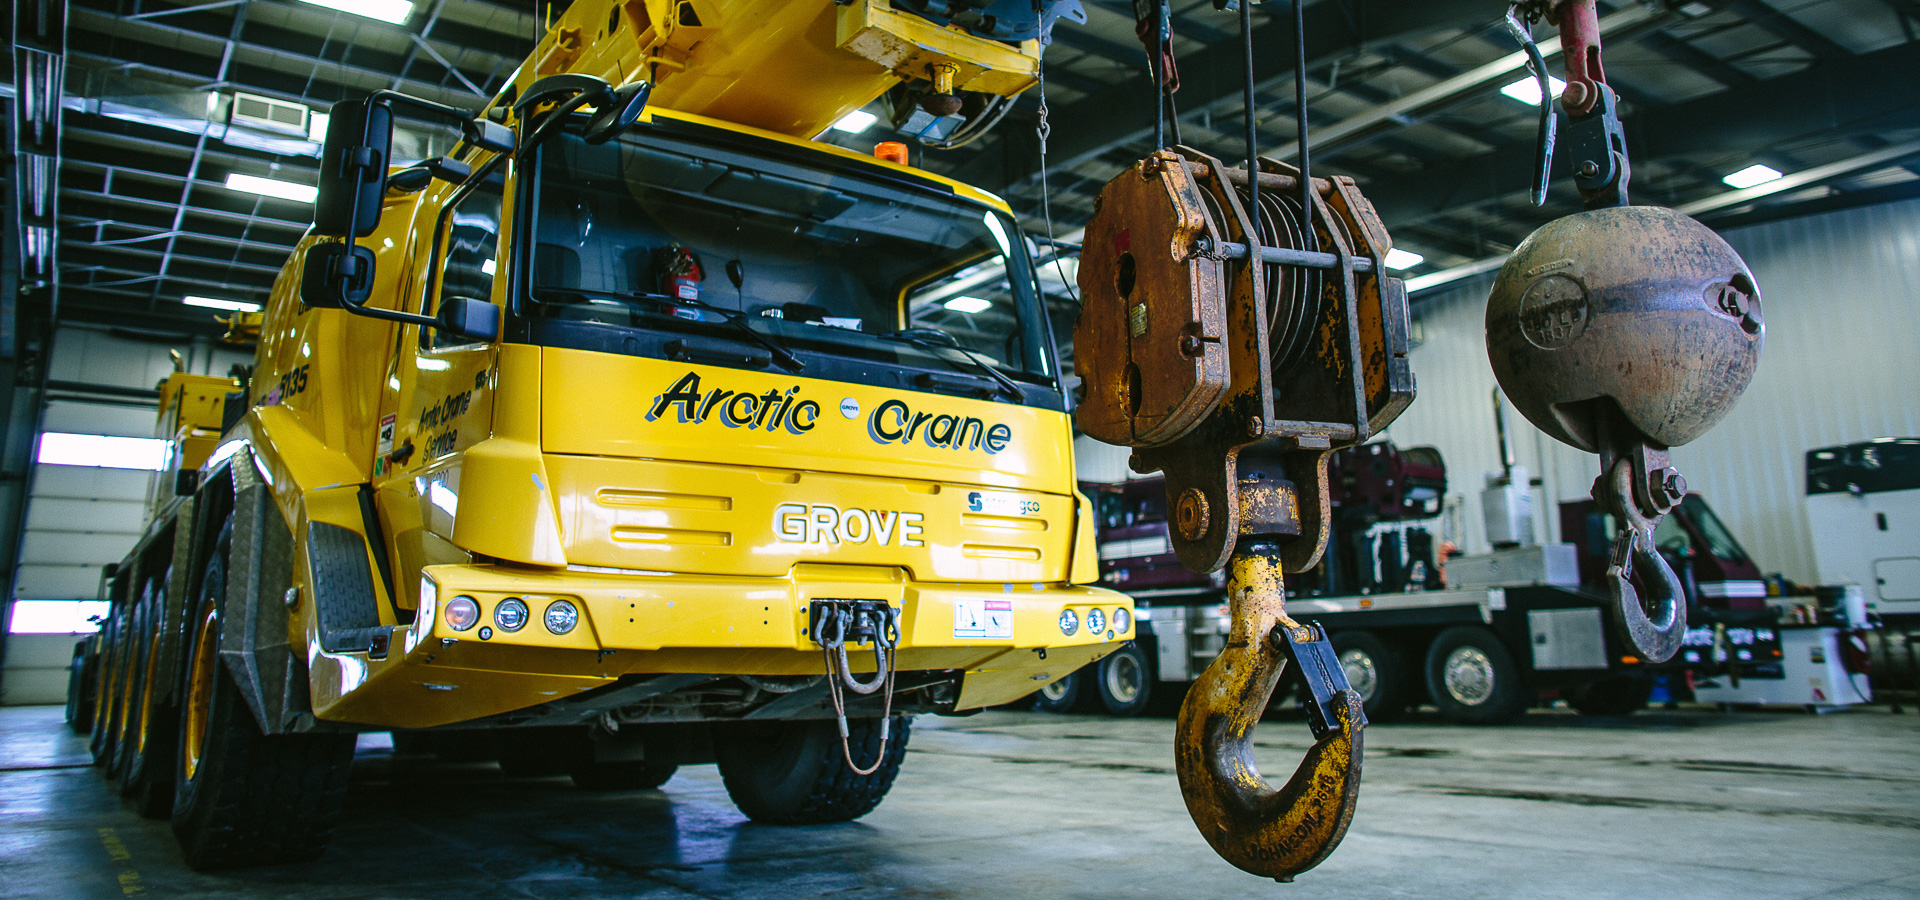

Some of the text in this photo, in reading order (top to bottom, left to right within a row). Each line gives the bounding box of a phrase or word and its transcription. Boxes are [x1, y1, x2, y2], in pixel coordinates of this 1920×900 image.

[279, 363, 309, 399] 5135
[416, 390, 471, 438] Arctic Crane
[646, 371, 1012, 454] Arctic Crane
[422, 424, 457, 465] Service
[774, 503, 925, 548] GROVE
[1249, 811, 1318, 860] JOHNSON
